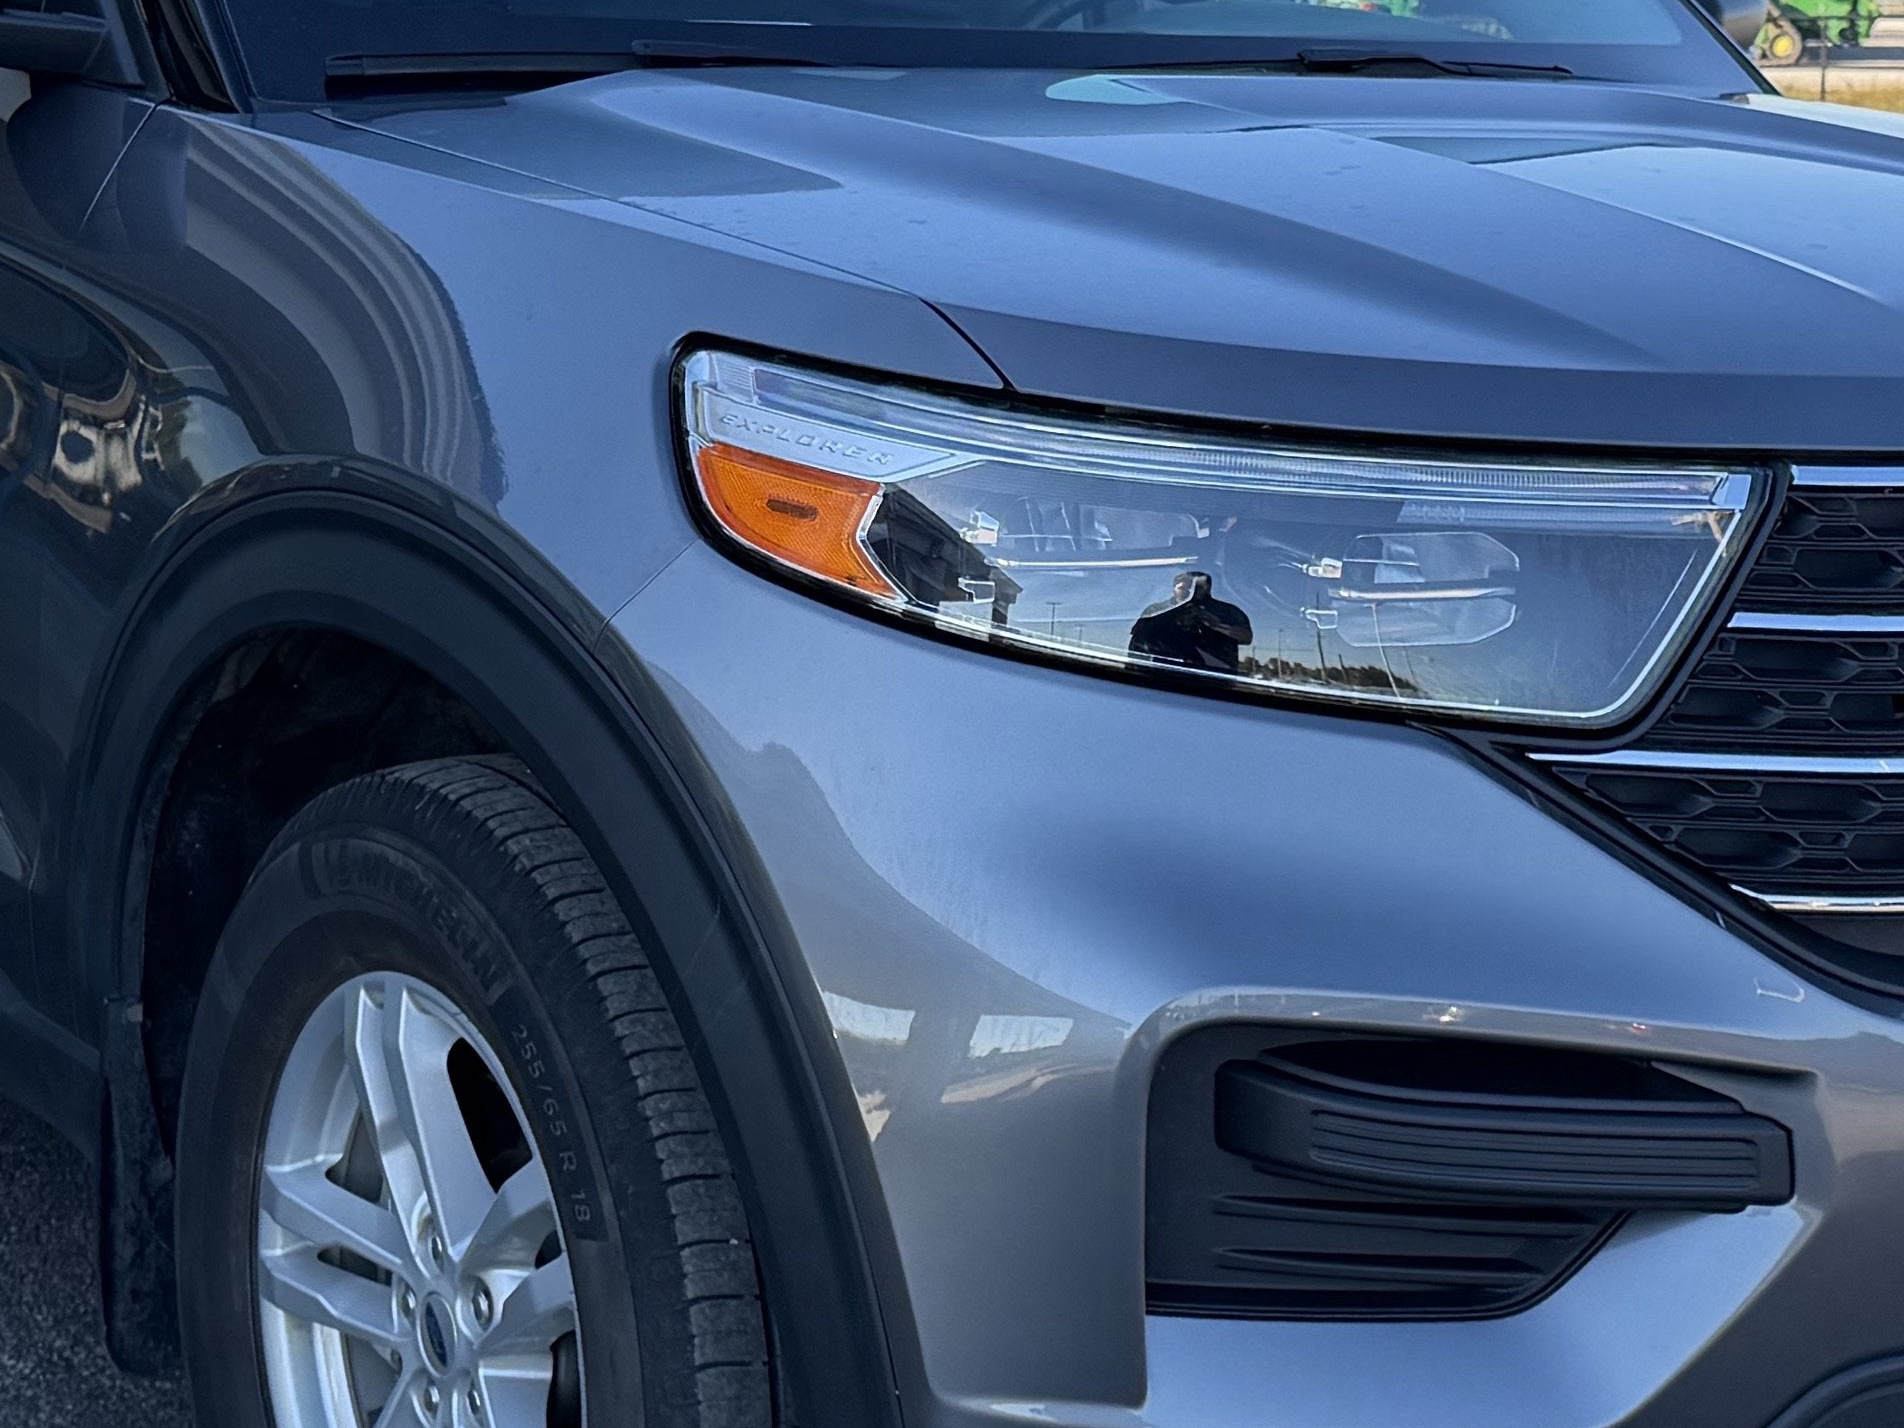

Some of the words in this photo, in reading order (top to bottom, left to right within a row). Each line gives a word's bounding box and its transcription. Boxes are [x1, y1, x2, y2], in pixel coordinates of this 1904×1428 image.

[720, 413, 895, 466] EXPLORER
[511, 1023, 569, 1138] 255/65
[559, 1150, 579, 1173] R
[570, 1189, 592, 1223] 18
